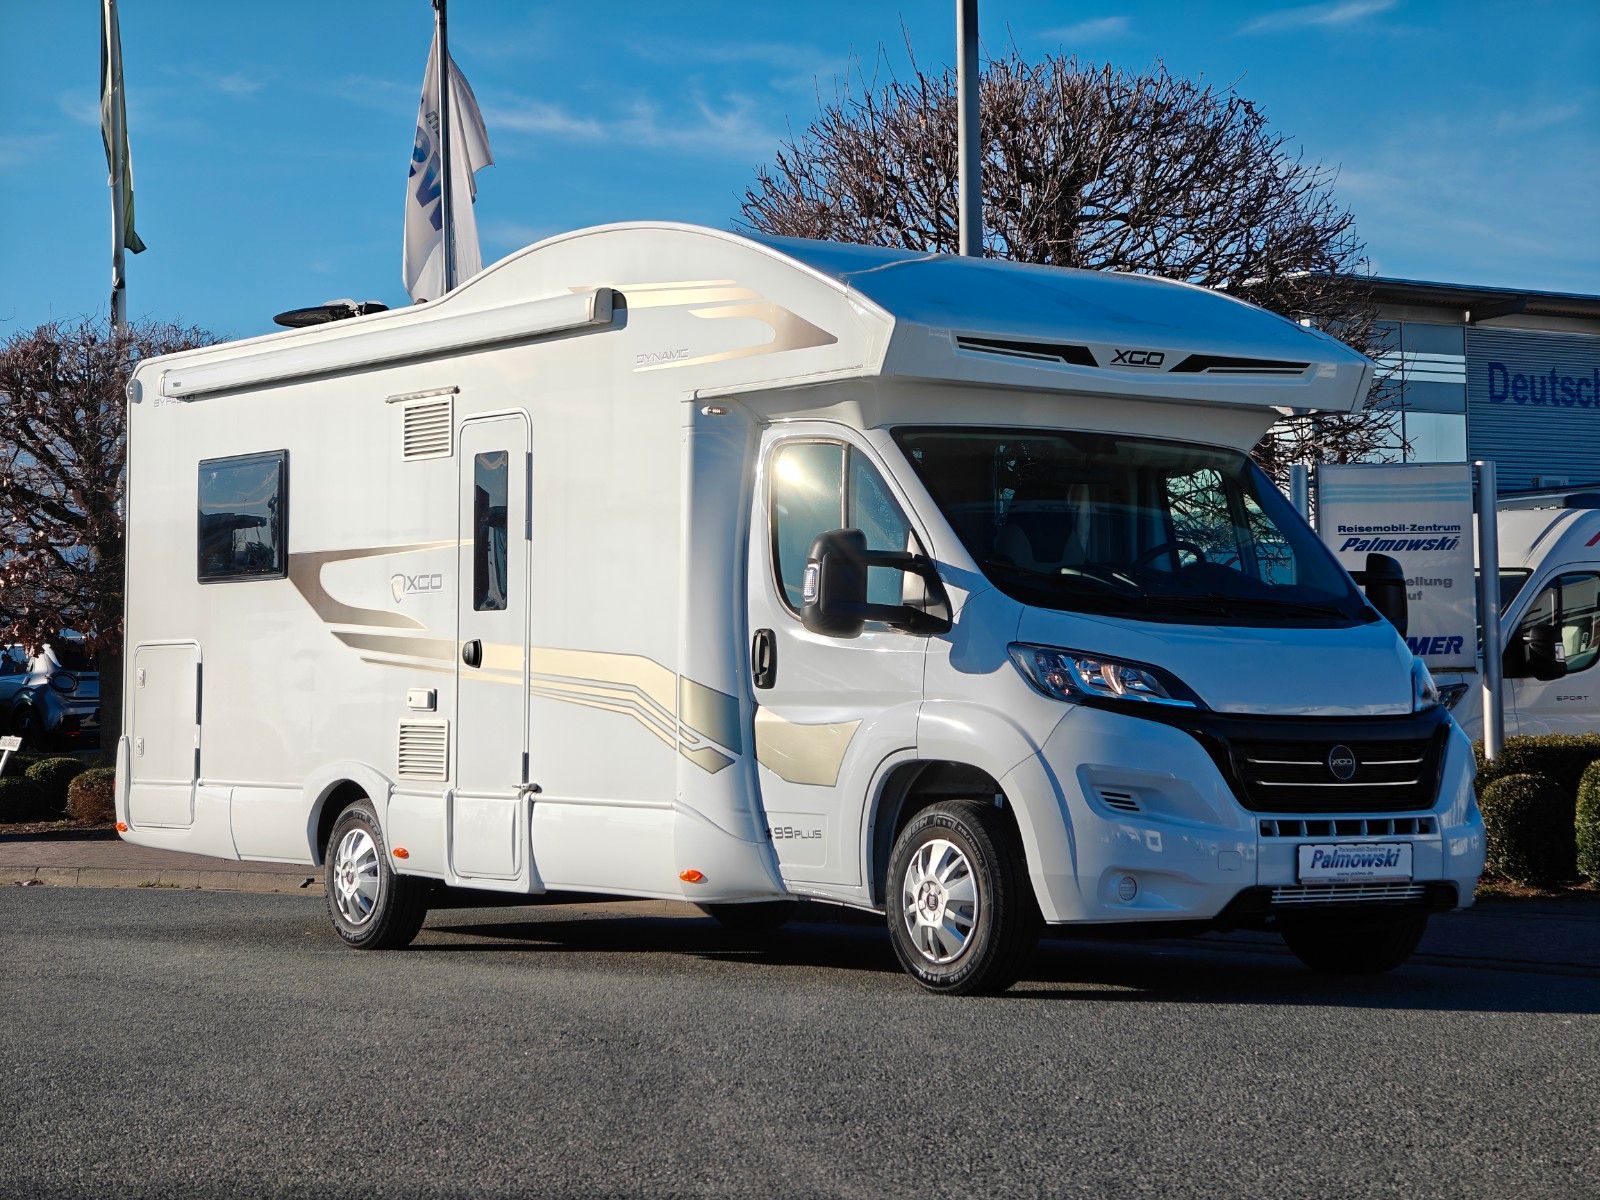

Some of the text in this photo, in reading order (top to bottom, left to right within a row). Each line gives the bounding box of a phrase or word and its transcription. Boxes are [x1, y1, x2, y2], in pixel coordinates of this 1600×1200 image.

[1110, 349, 1165, 366] XGO
[1337, 523, 1461, 533] Reisemobil-Zentrum
[1339, 535, 1460, 552] Palmowski
[406, 573, 443, 591] XGO
[1406, 576, 1453, 588] ellung
[1406, 635, 1464, 656] MER
[1310, 848, 1400, 869] Palmowski
